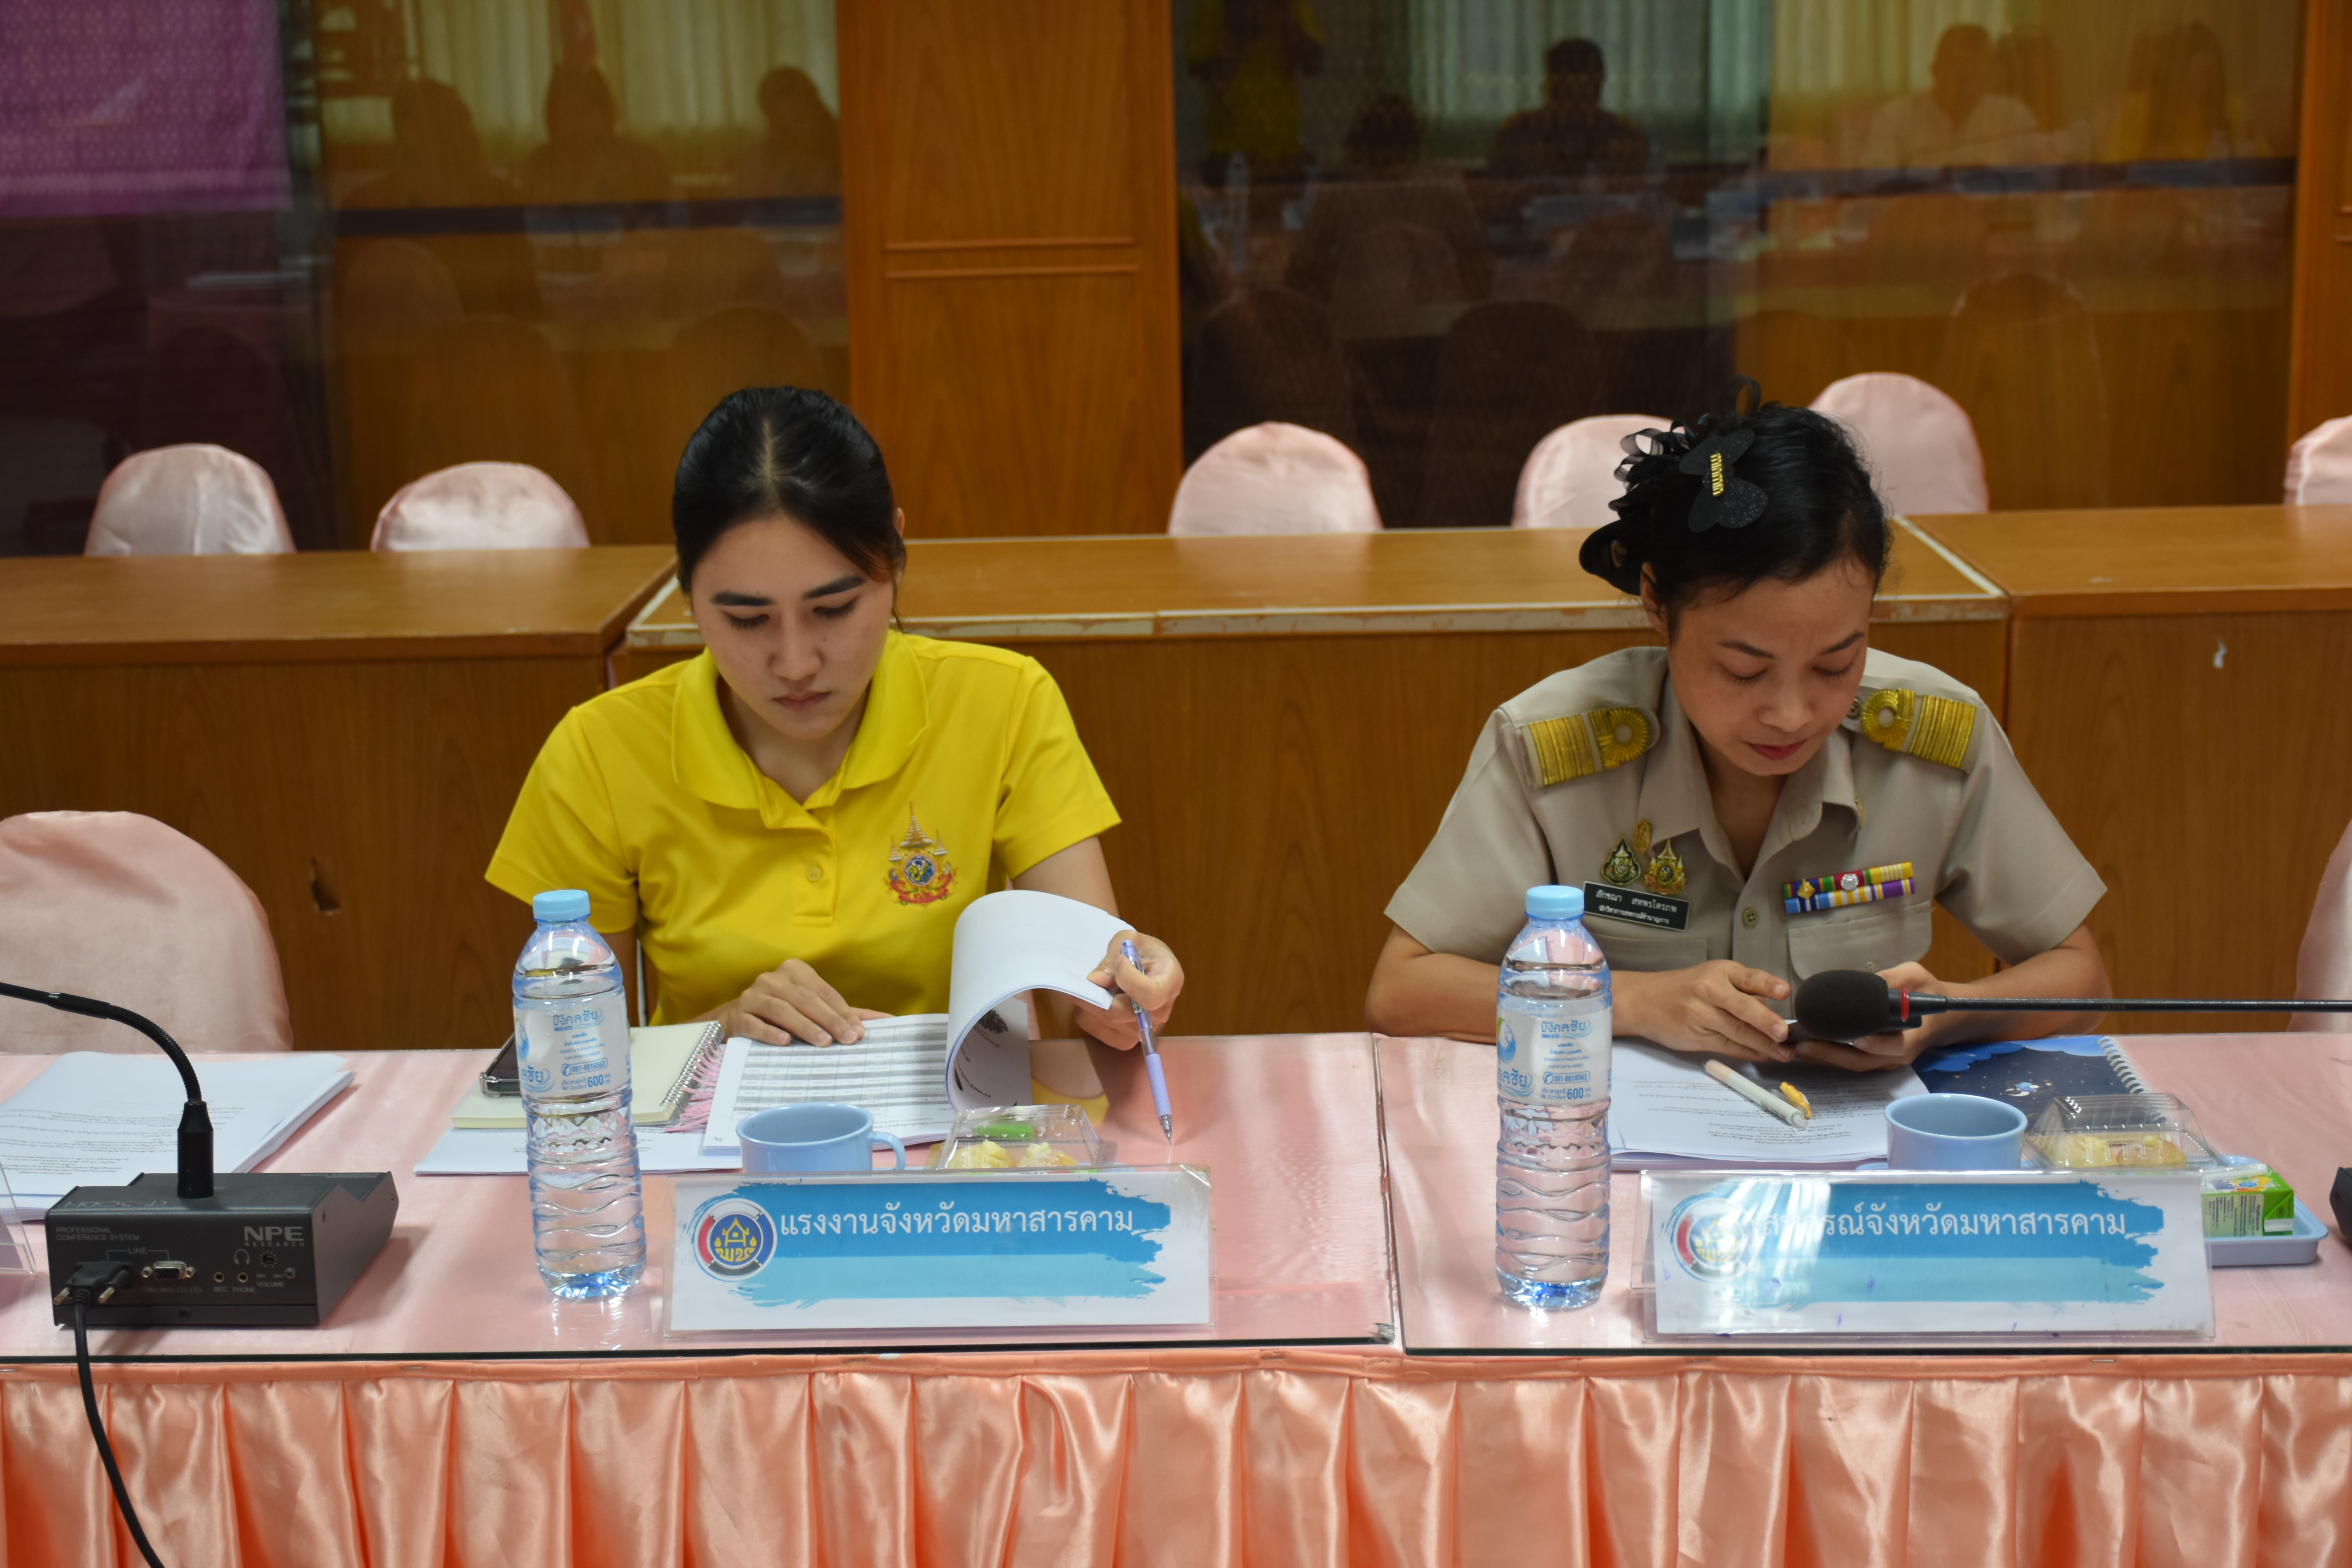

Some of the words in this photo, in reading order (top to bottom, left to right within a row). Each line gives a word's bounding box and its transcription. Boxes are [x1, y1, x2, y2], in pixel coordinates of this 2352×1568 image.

[588, 1074, 604, 1087] 600
[1567, 1087, 1584, 1099] 600
[781, 1201, 1132, 1235] แรงงานจังหวัดมหาสารคาม
[244, 1226, 304, 1241] NPE
